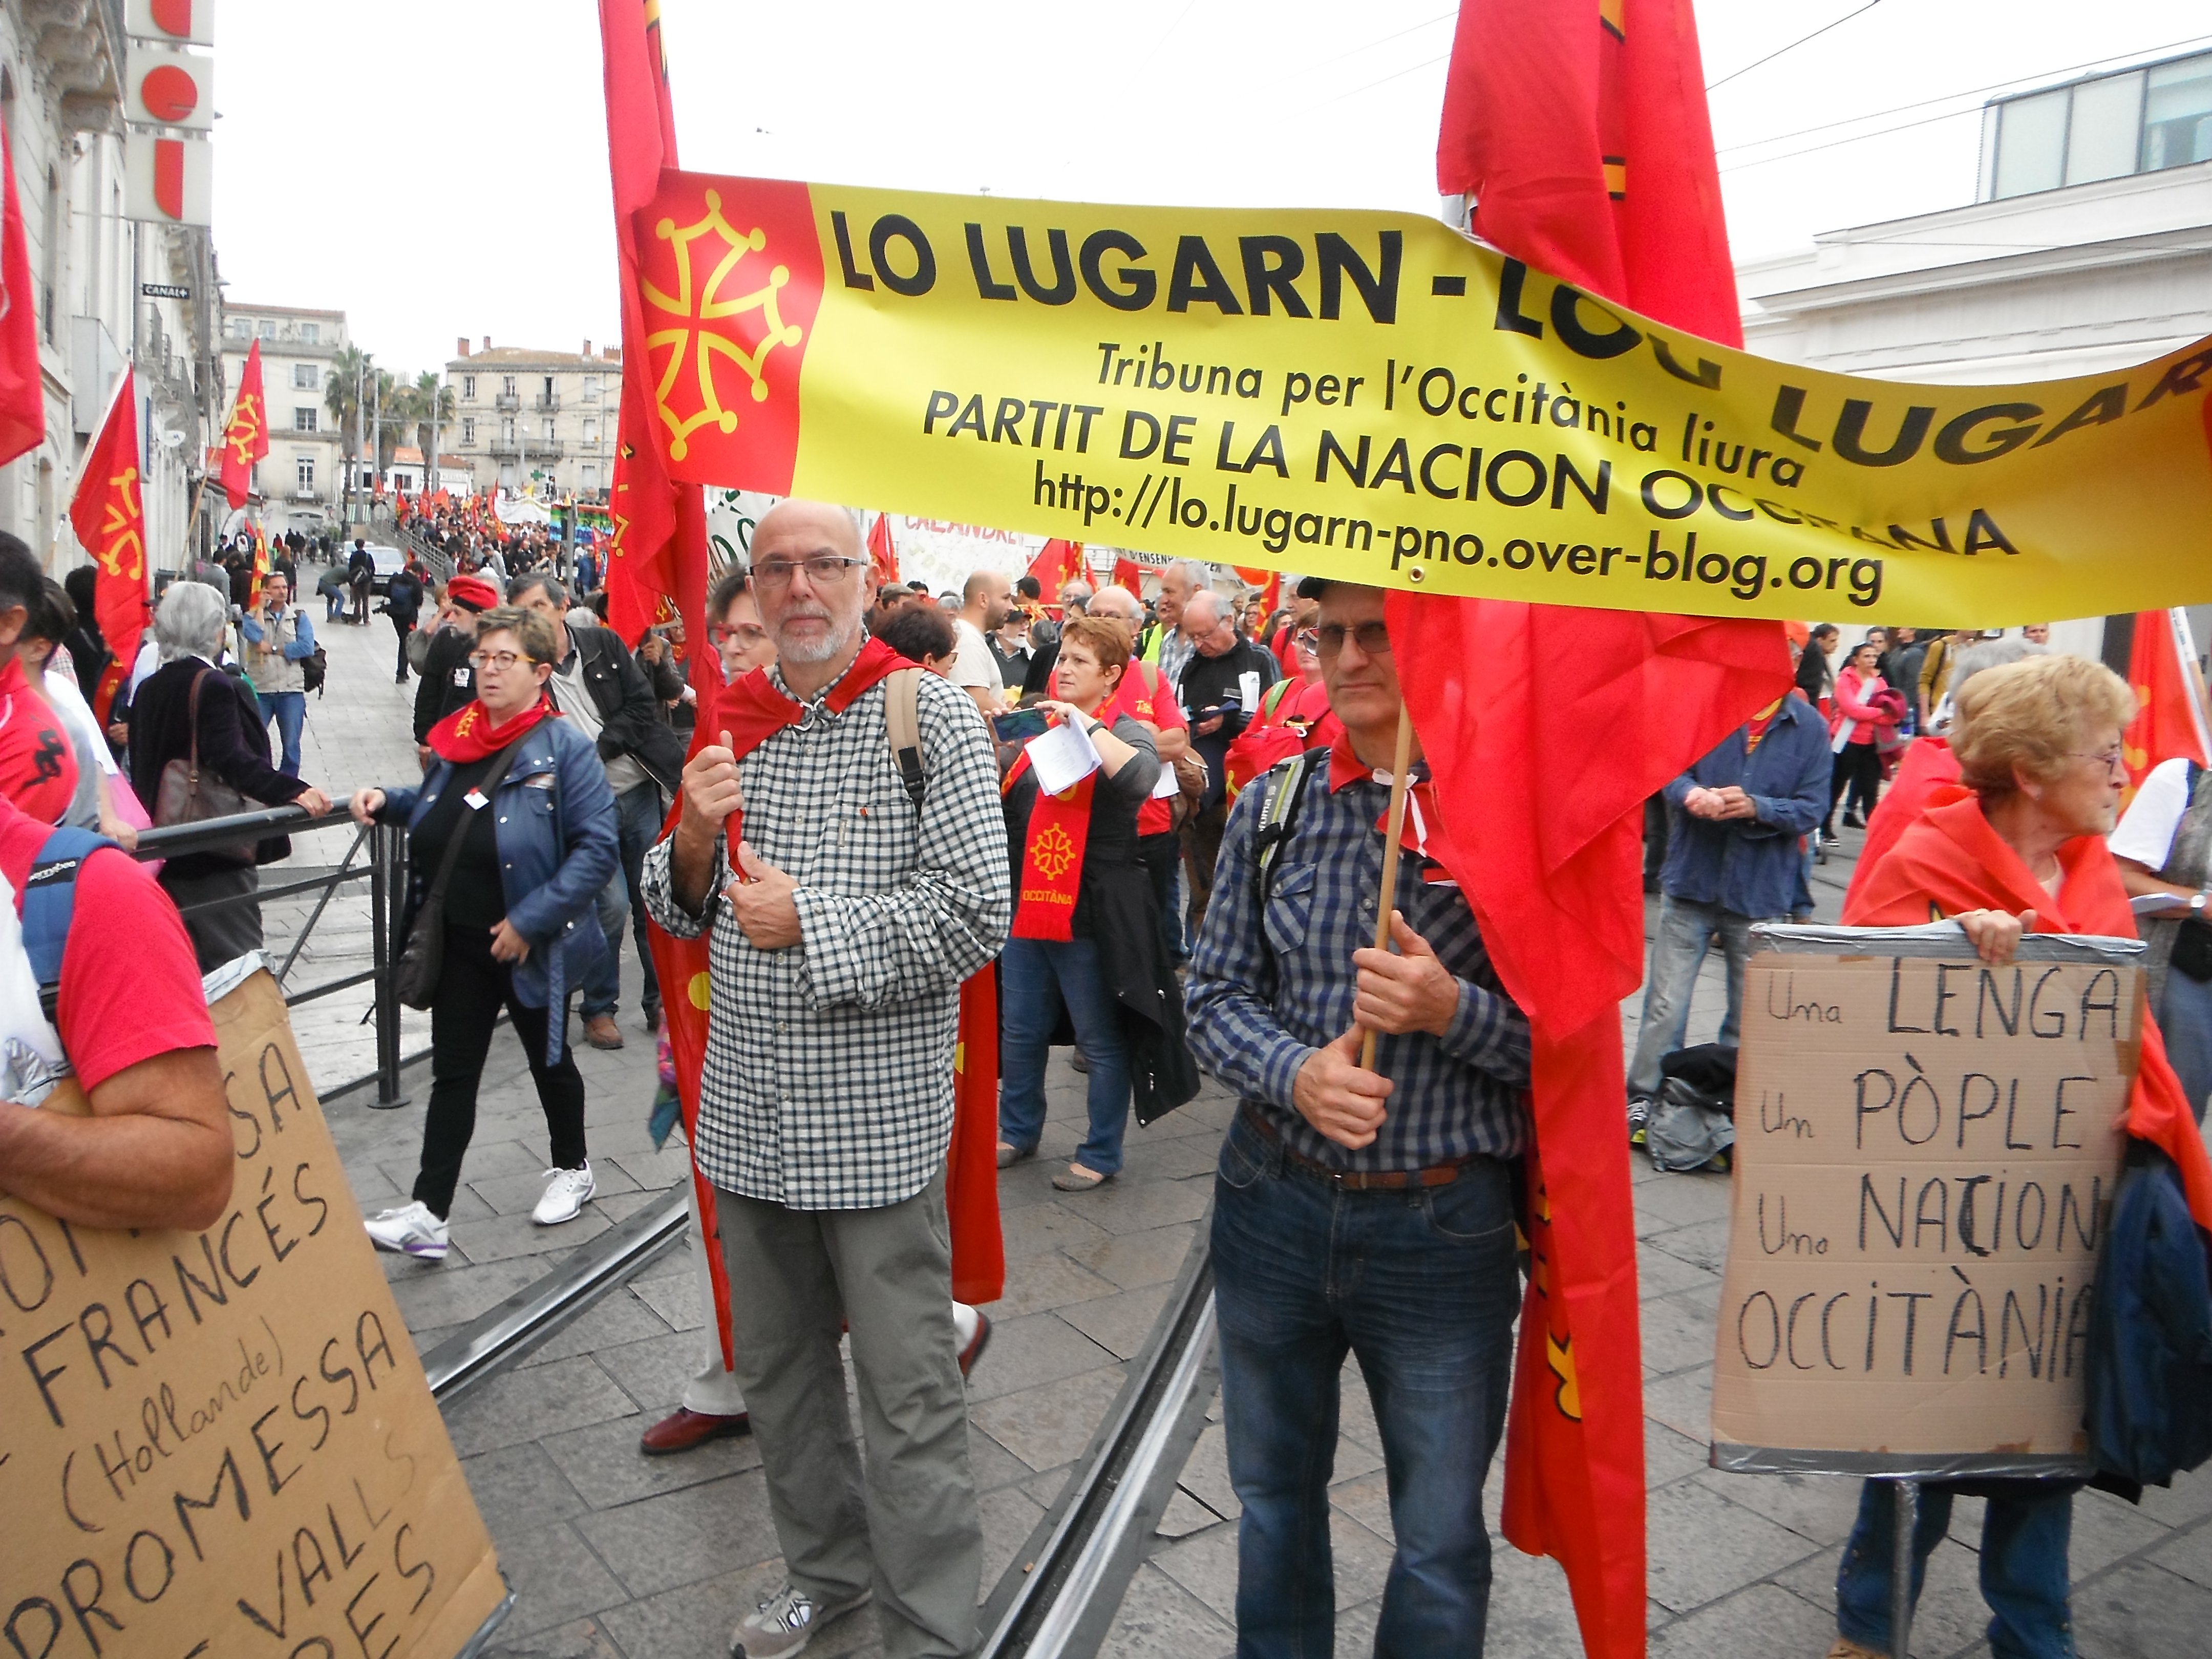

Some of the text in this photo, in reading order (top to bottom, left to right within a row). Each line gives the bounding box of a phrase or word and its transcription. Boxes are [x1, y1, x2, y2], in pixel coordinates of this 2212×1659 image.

[145, 285, 188, 297] CANAL+
[831, 210, 937, 296] LO
[964, 222, 1402, 325] LUGARN
[923, 390, 1104, 454] PARTIT
[1118, 410, 1197, 466] DE
[1215, 421, 1290, 479] LA
[1315, 429, 1612, 515] NACION
[1098, 341, 1806, 488] Tribuna per l'Occitània liura
[1033, 459, 1883, 607] http://lo.lugarn-pno.over-blog.org
[1768, 956, 2121, 1041] Una LENGA
[1760, 1052, 2098, 1150] Un PÒPLE
[22, 1162, 328, 1428] FRANCÉS
[4, 1311, 396, 1659] PROMESSA
[237, 1431, 416, 1639] VALLS
